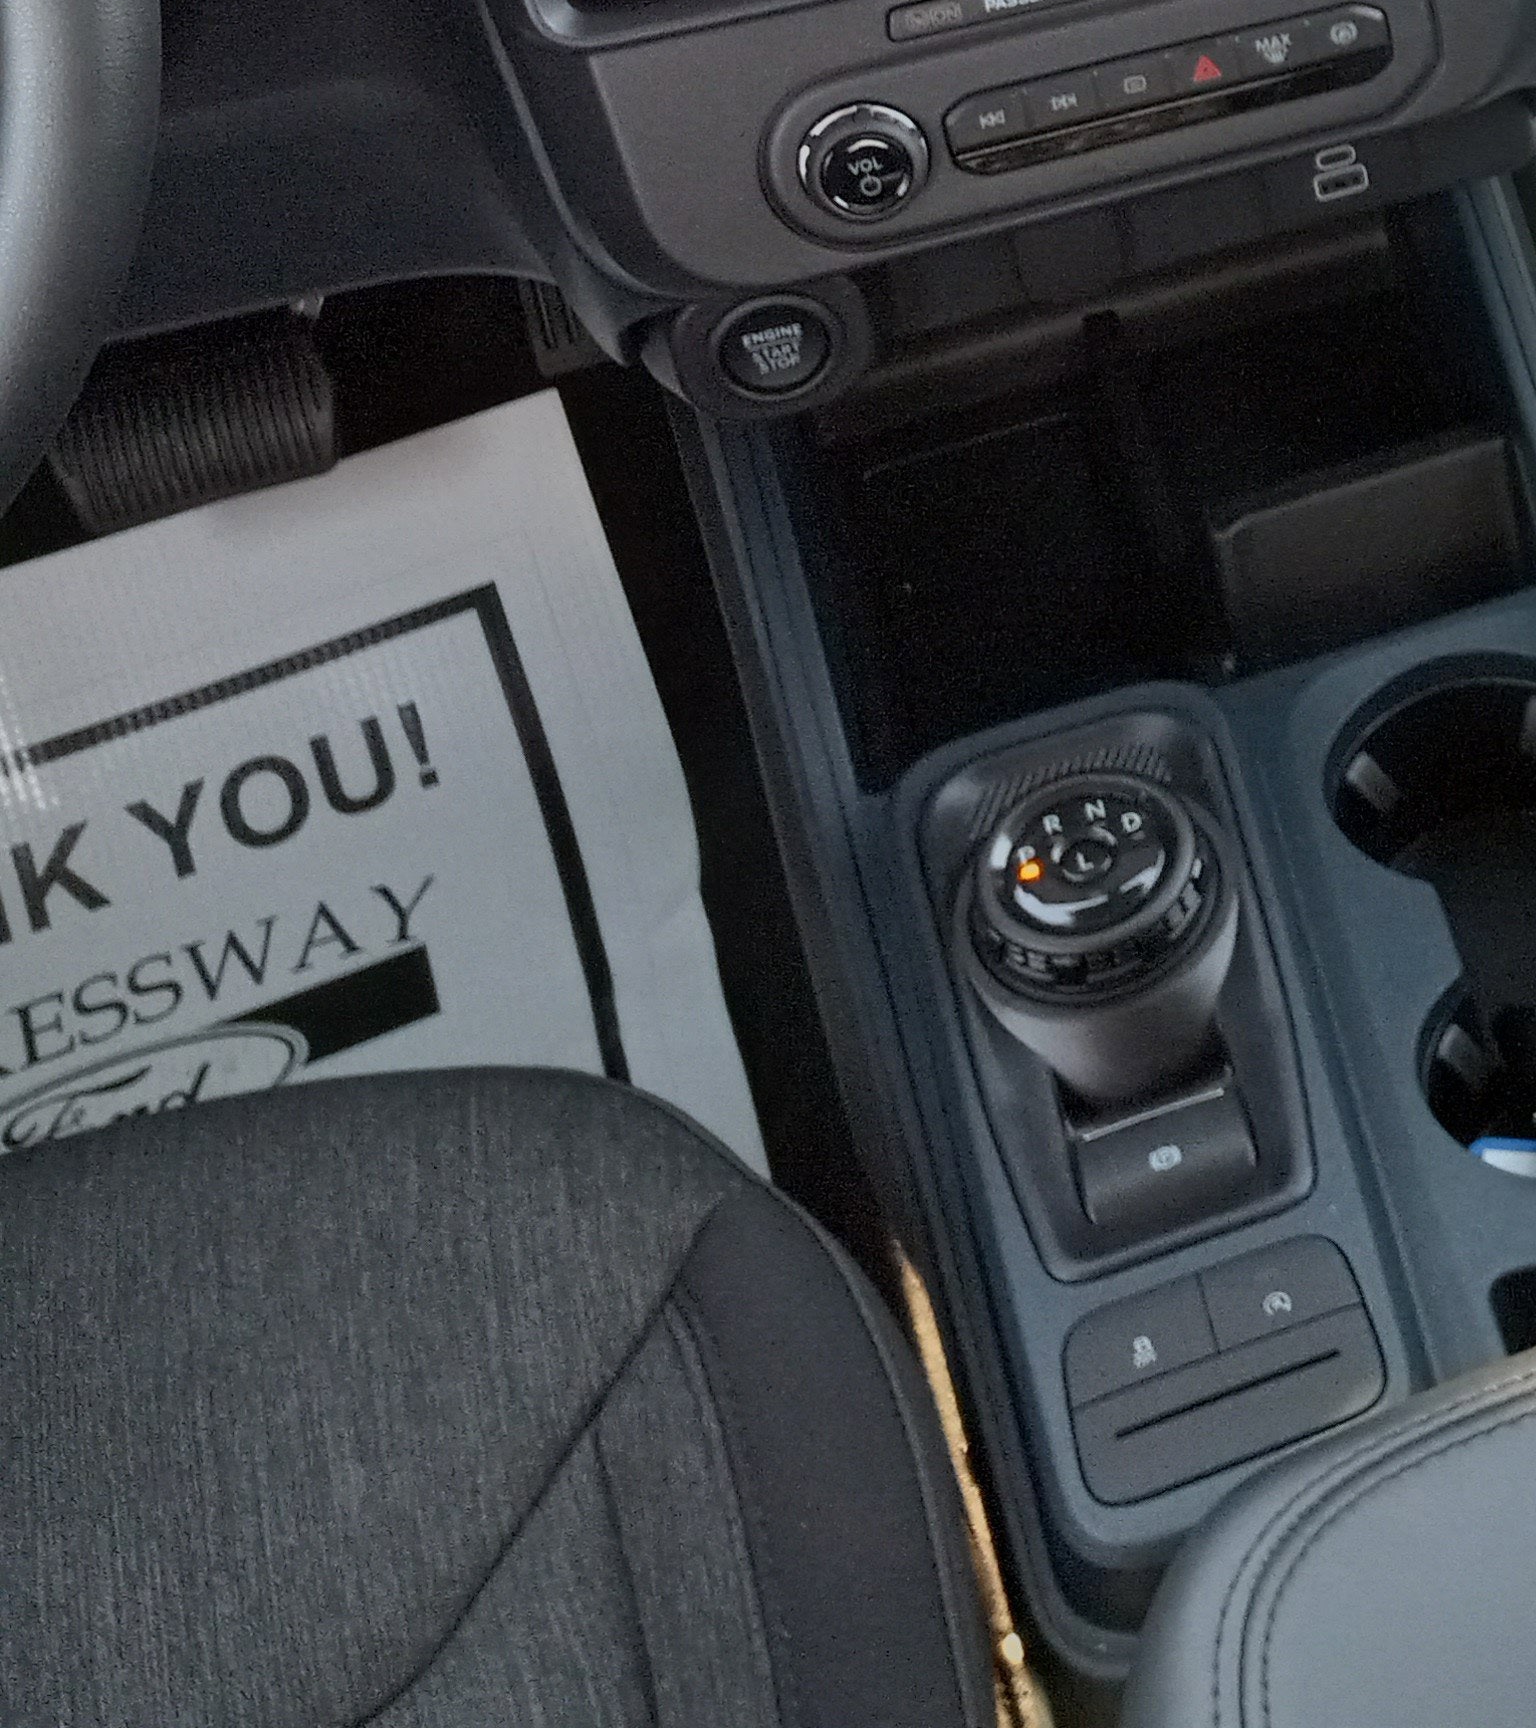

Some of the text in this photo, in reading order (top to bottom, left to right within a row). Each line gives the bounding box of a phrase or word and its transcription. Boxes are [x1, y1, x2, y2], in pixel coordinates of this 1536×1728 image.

[1255, 32, 1291, 54] MAX
[847, 156, 884, 176] VOL
[742, 322, 803, 349] ENGINE
[125, 702, 440, 879] YOU!
[1084, 799, 1106, 821] N
[1042, 814, 1062, 834] R
[1120, 812, 1142, 833] D
[0, 875, 435, 1078] ESSWAY
